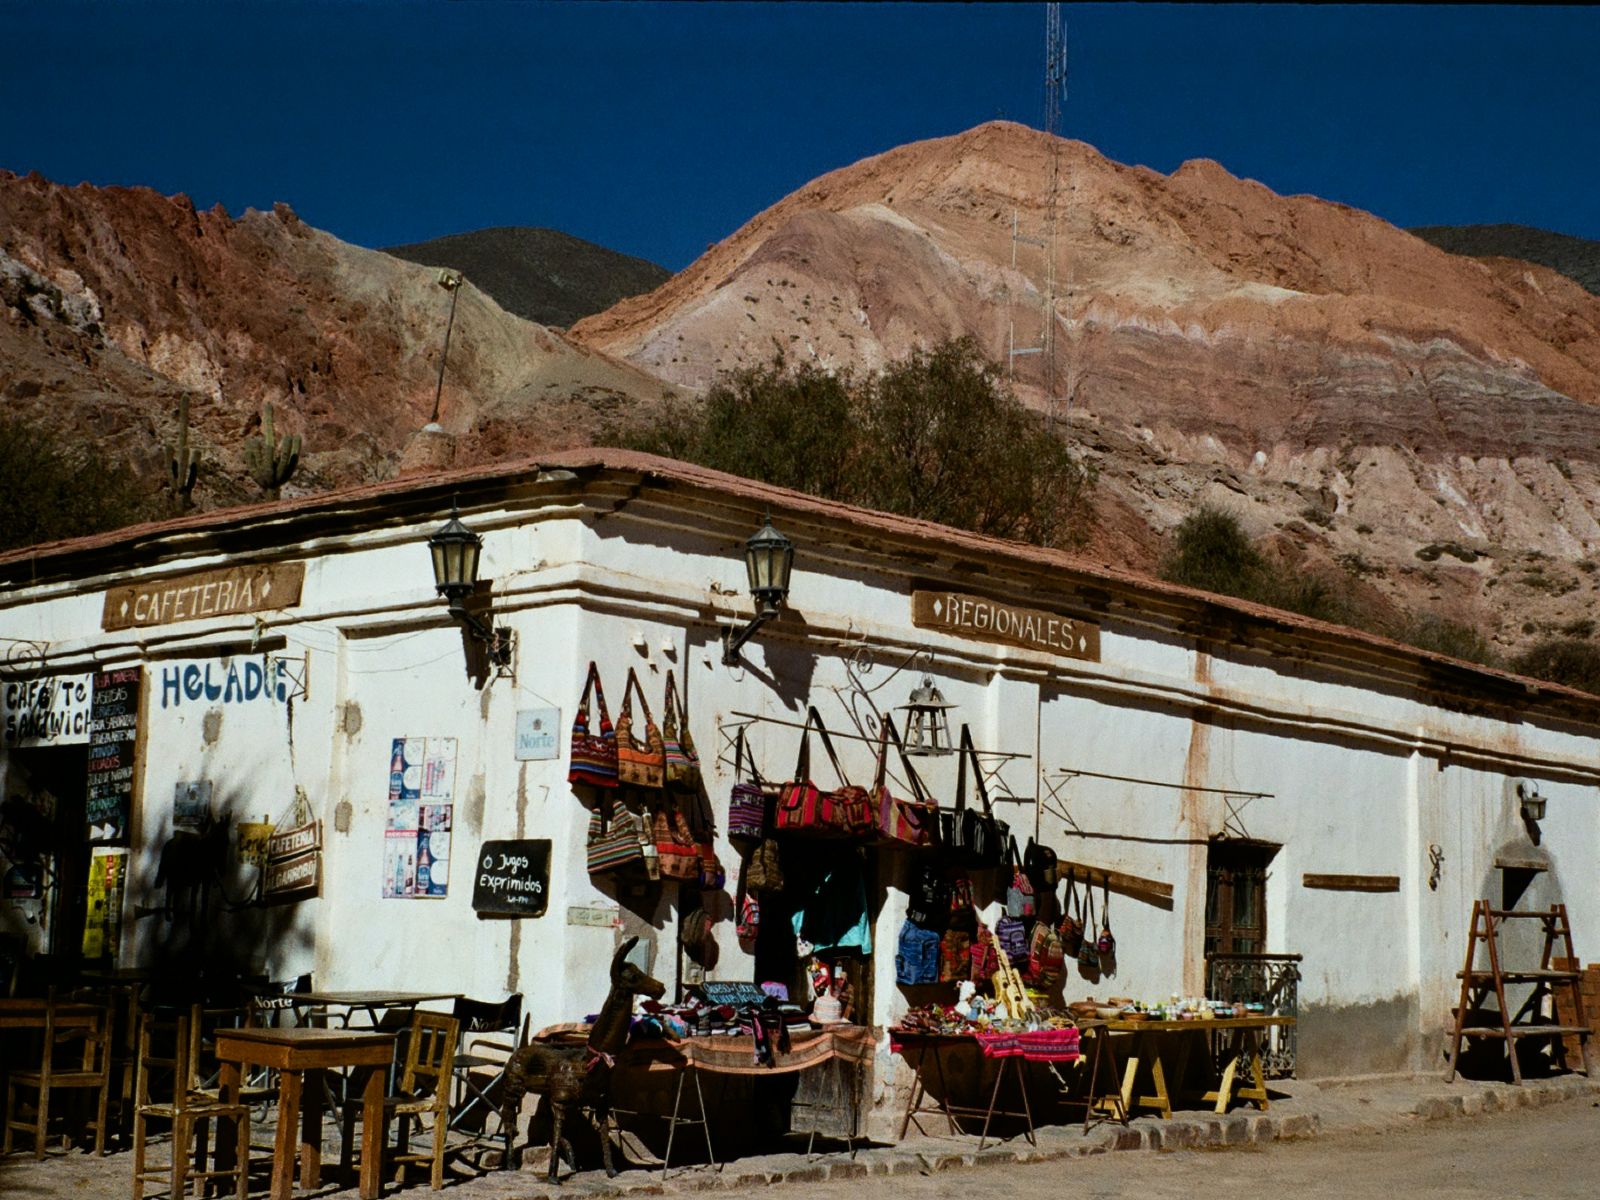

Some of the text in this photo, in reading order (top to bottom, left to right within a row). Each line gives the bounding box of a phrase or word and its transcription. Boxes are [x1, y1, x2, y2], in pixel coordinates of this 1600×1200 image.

[134, 577, 253, 622] CAFETERIA
[945, 596, 1075, 651] REGIONALES
[519, 733, 555, 750] Norte
[271, 827, 315, 855] CAFETERIA
[497, 854, 529, 875] Jugos
[480, 873, 542, 894] Exprimidos
[254, 995, 293, 1009] Norte
